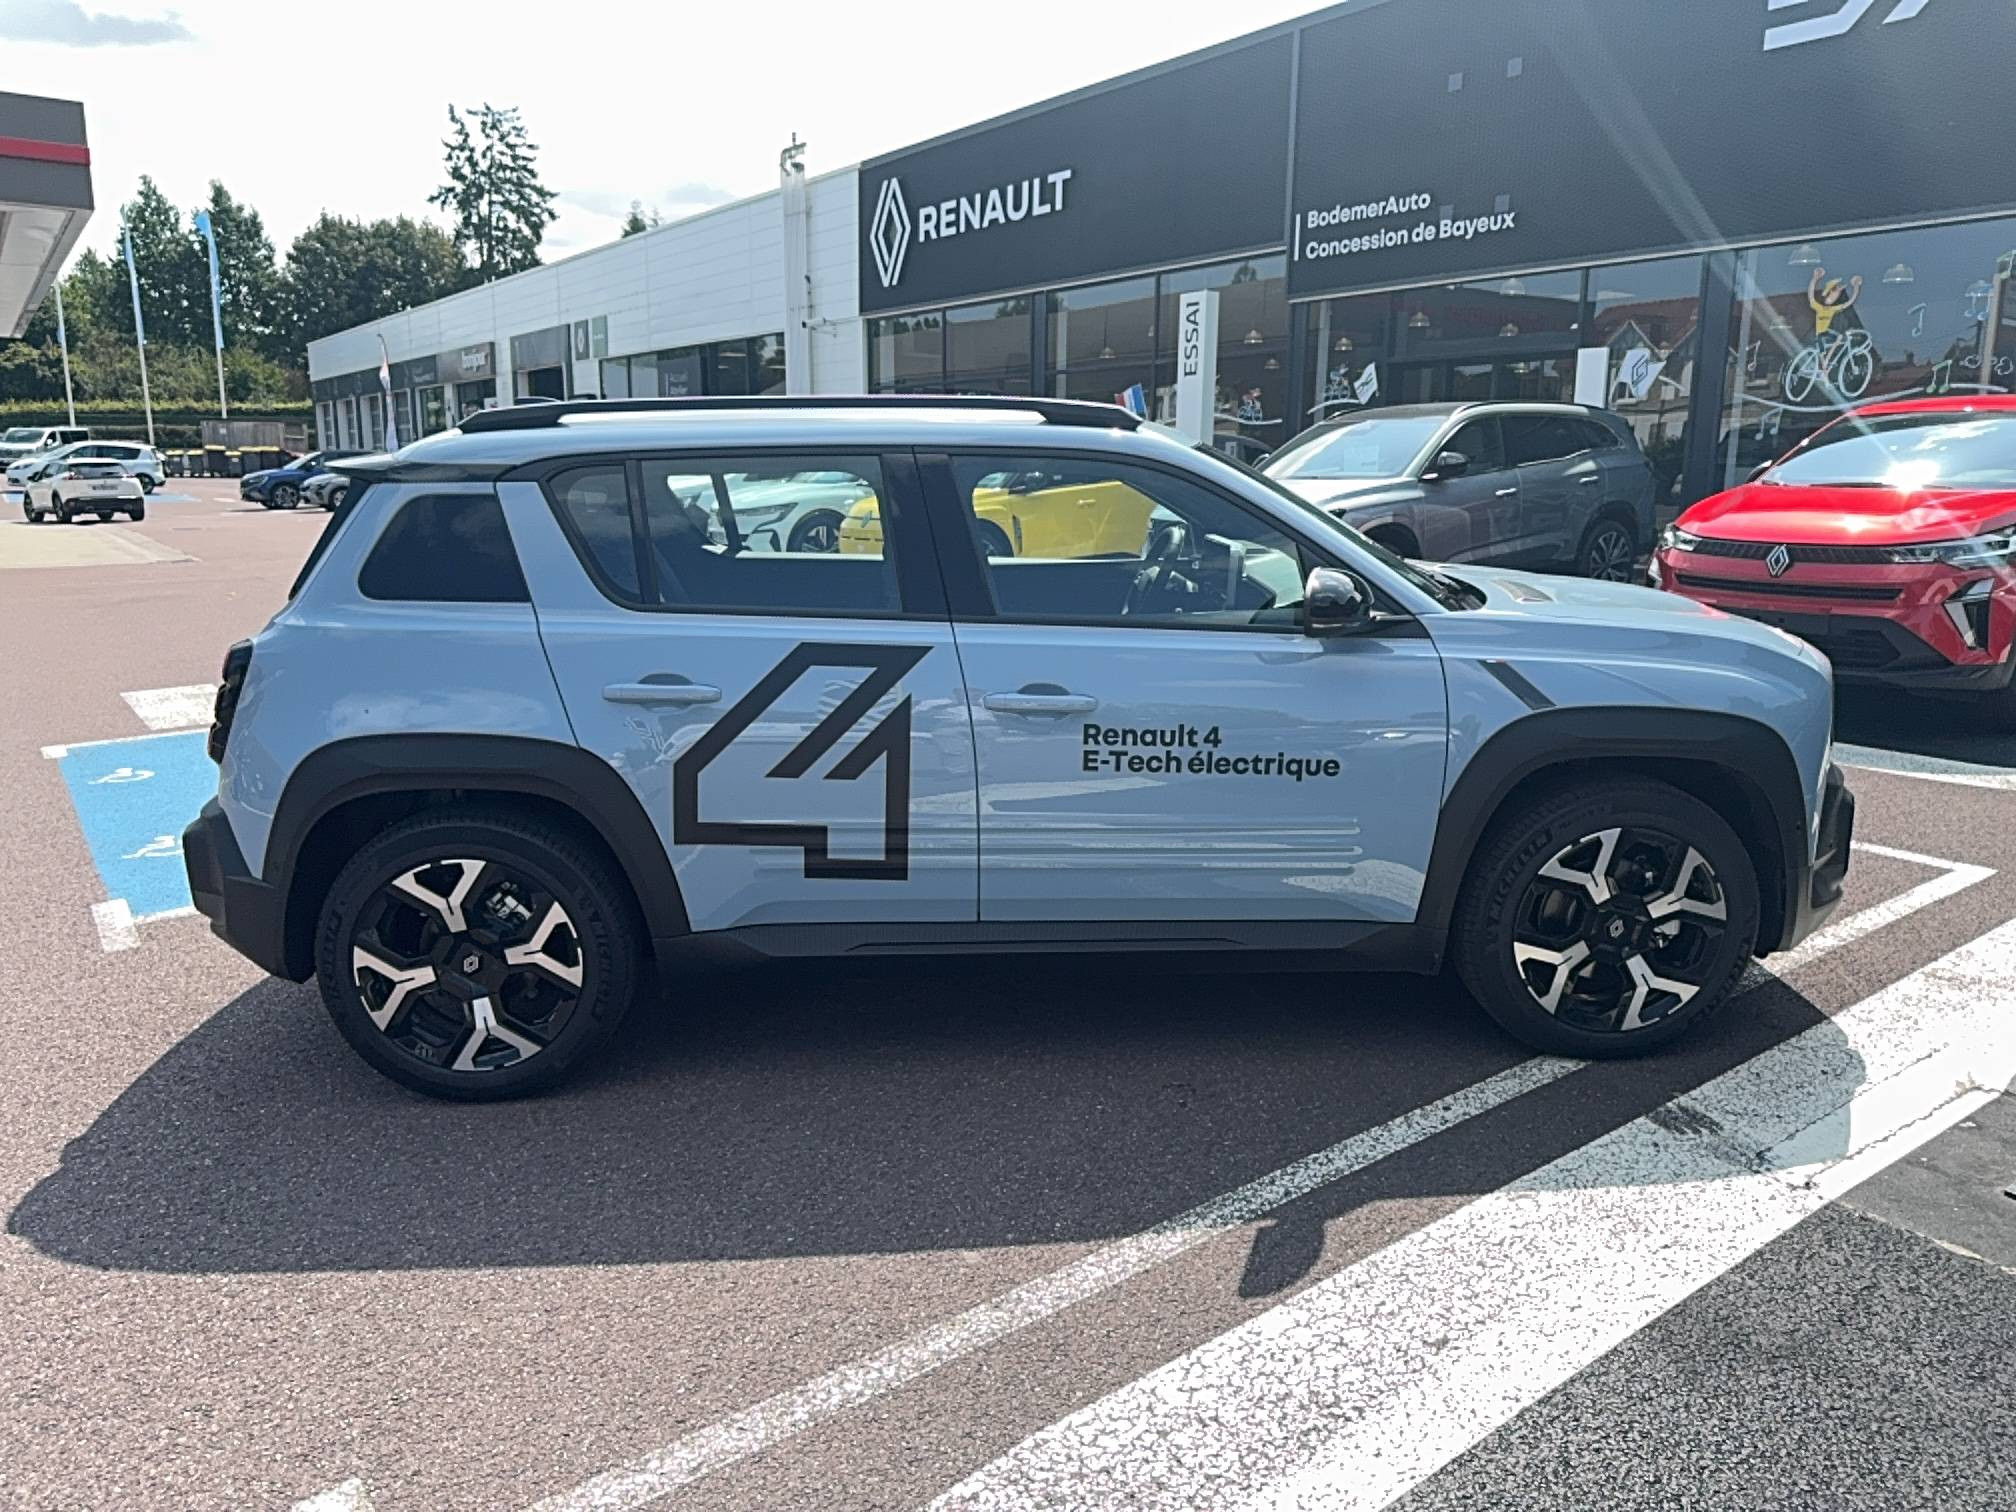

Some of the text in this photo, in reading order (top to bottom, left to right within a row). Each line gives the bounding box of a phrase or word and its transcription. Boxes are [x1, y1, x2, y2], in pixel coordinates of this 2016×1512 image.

[918, 169, 1072, 243] RENAULT
[1305, 212, 1516, 259] Concession de Bayeux
[1307, 193, 1431, 228] BodemerAuto
[1184, 301, 1200, 377] ESSAI
[673, 641, 935, 880] 4
[1082, 749, 1341, 782] E-Tech électrique
[1083, 723, 1222, 748] Renault 4
[1488, 830, 1551, 921] MICHELIN
